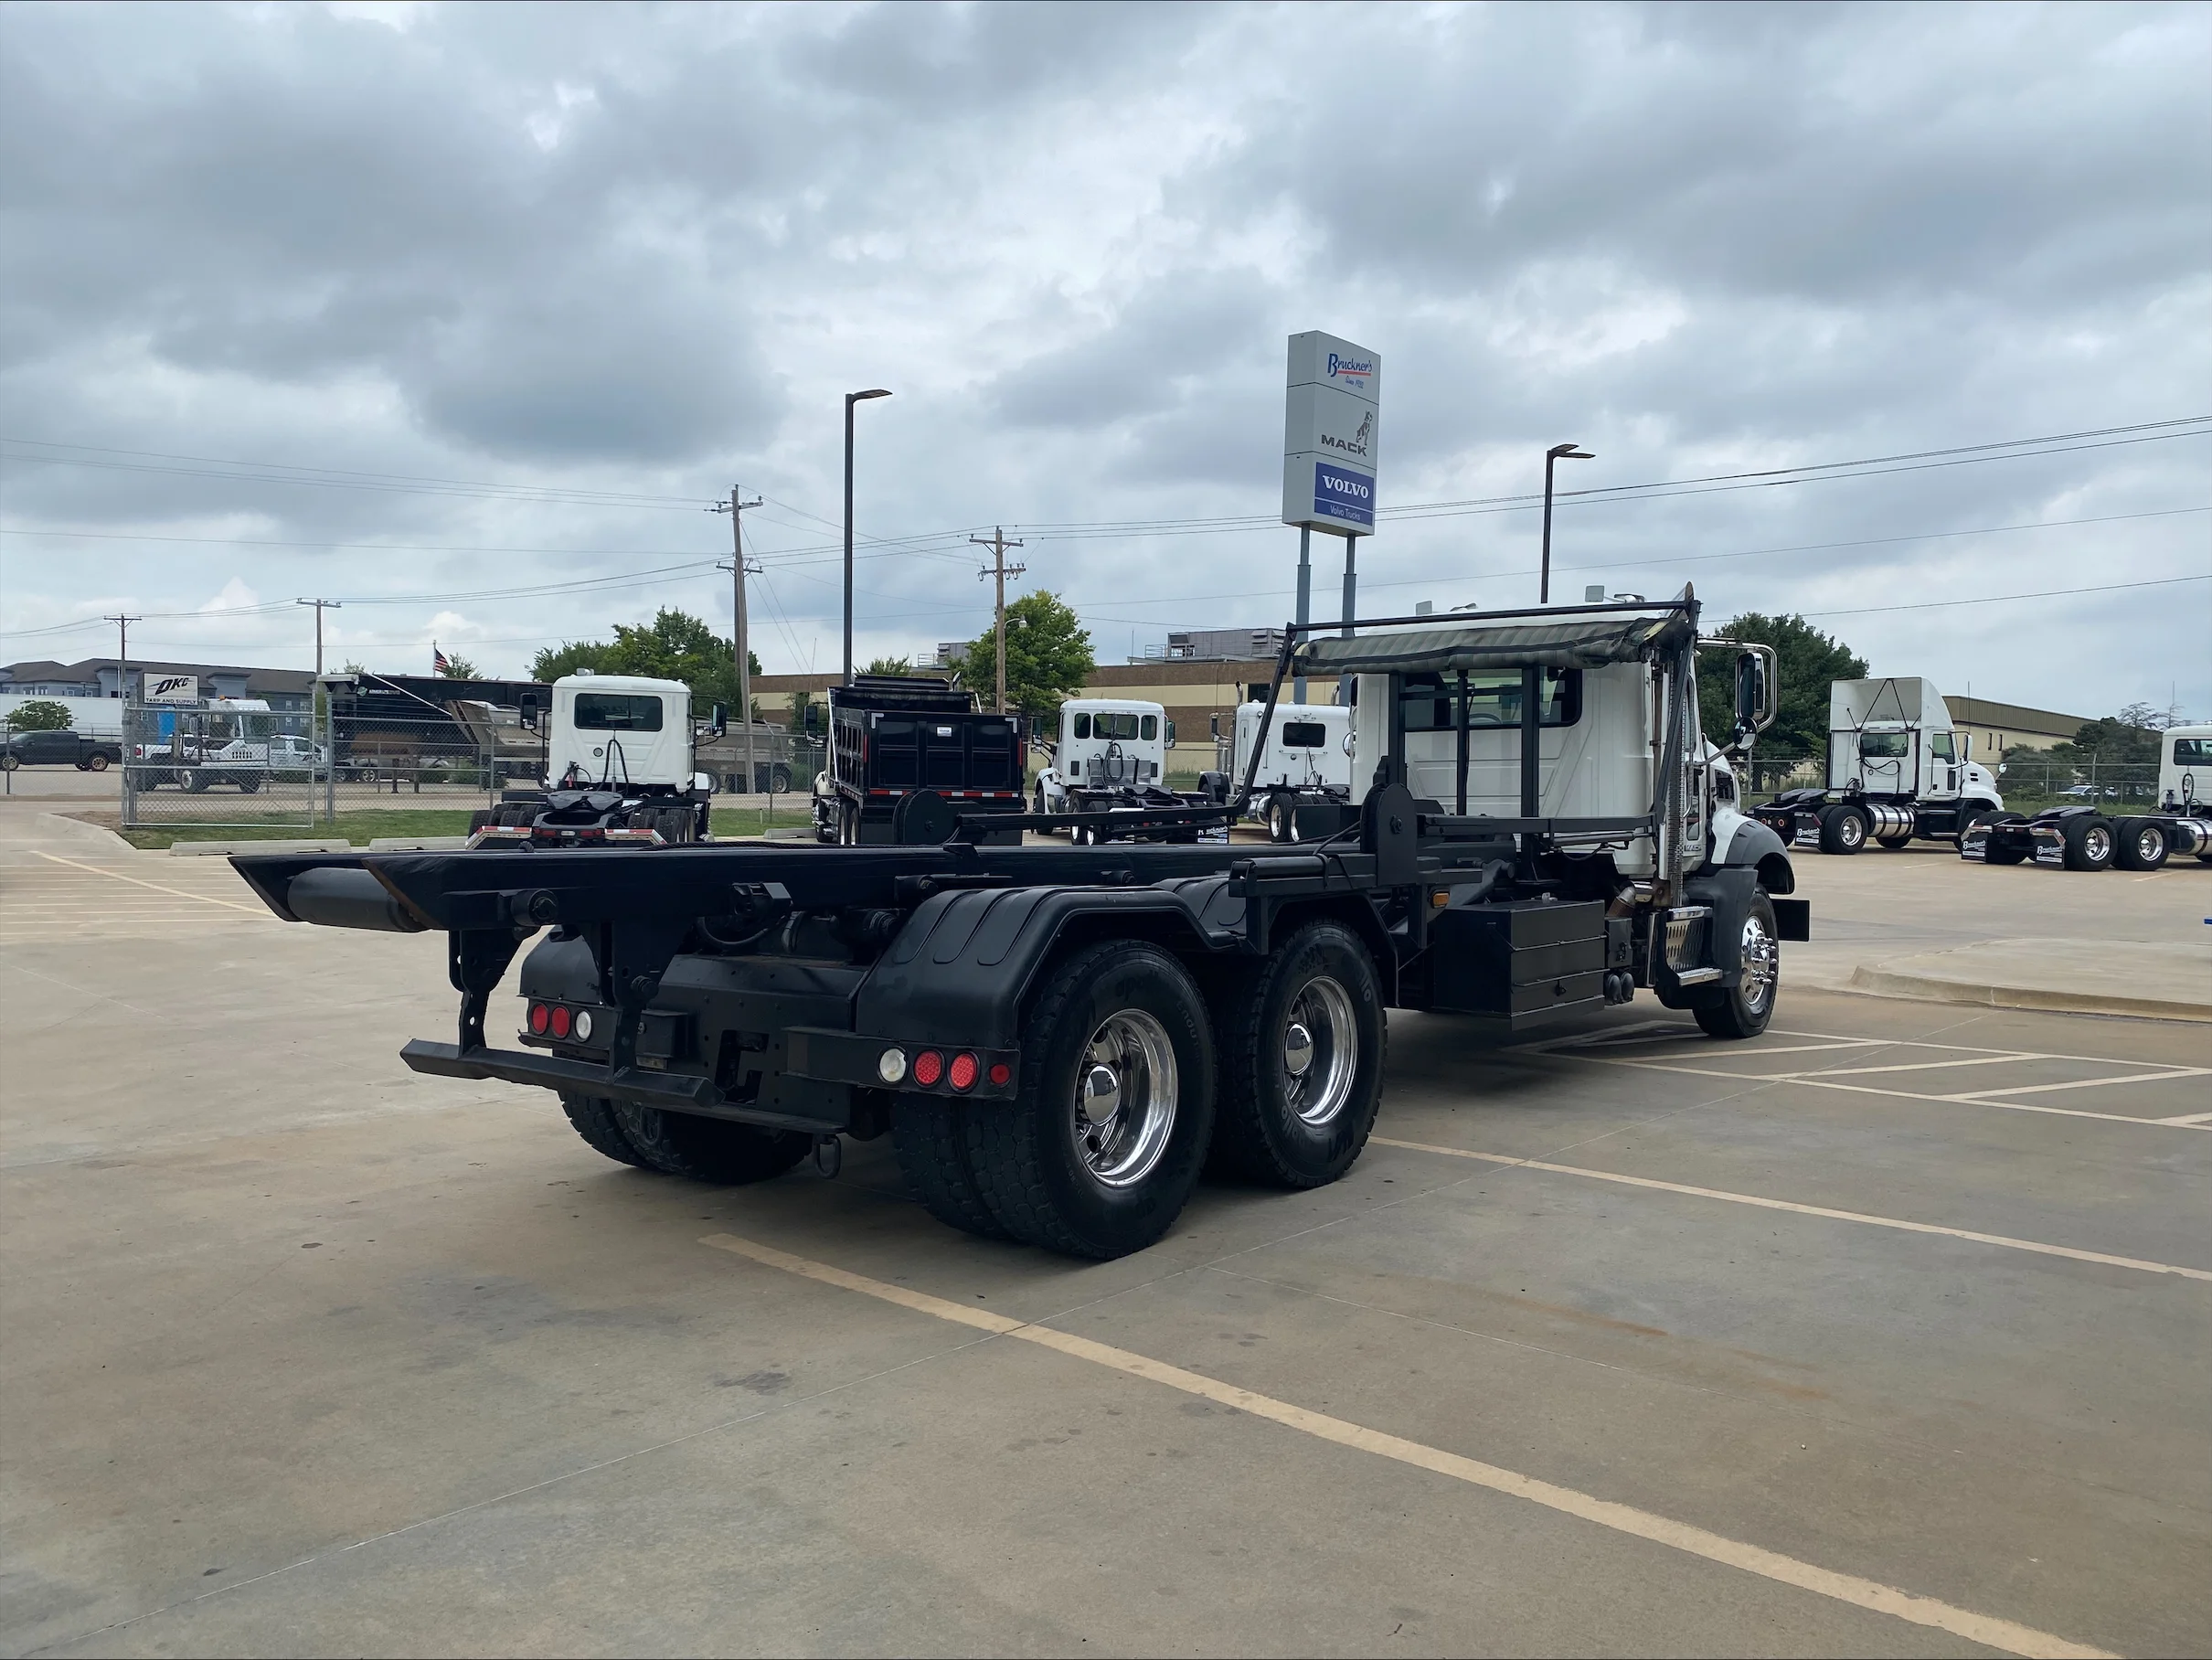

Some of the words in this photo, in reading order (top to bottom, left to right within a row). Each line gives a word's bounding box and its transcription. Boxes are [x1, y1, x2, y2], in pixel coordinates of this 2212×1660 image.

[1327, 353, 1373, 378] Bruckner's
[1321, 434, 1367, 457] MACK
[1322, 475, 1369, 499] VOLVO
[1330, 505, 1345, 516] Volvo
[1345, 508, 1361, 521] Trucks
[155, 677, 190, 696] OKC
